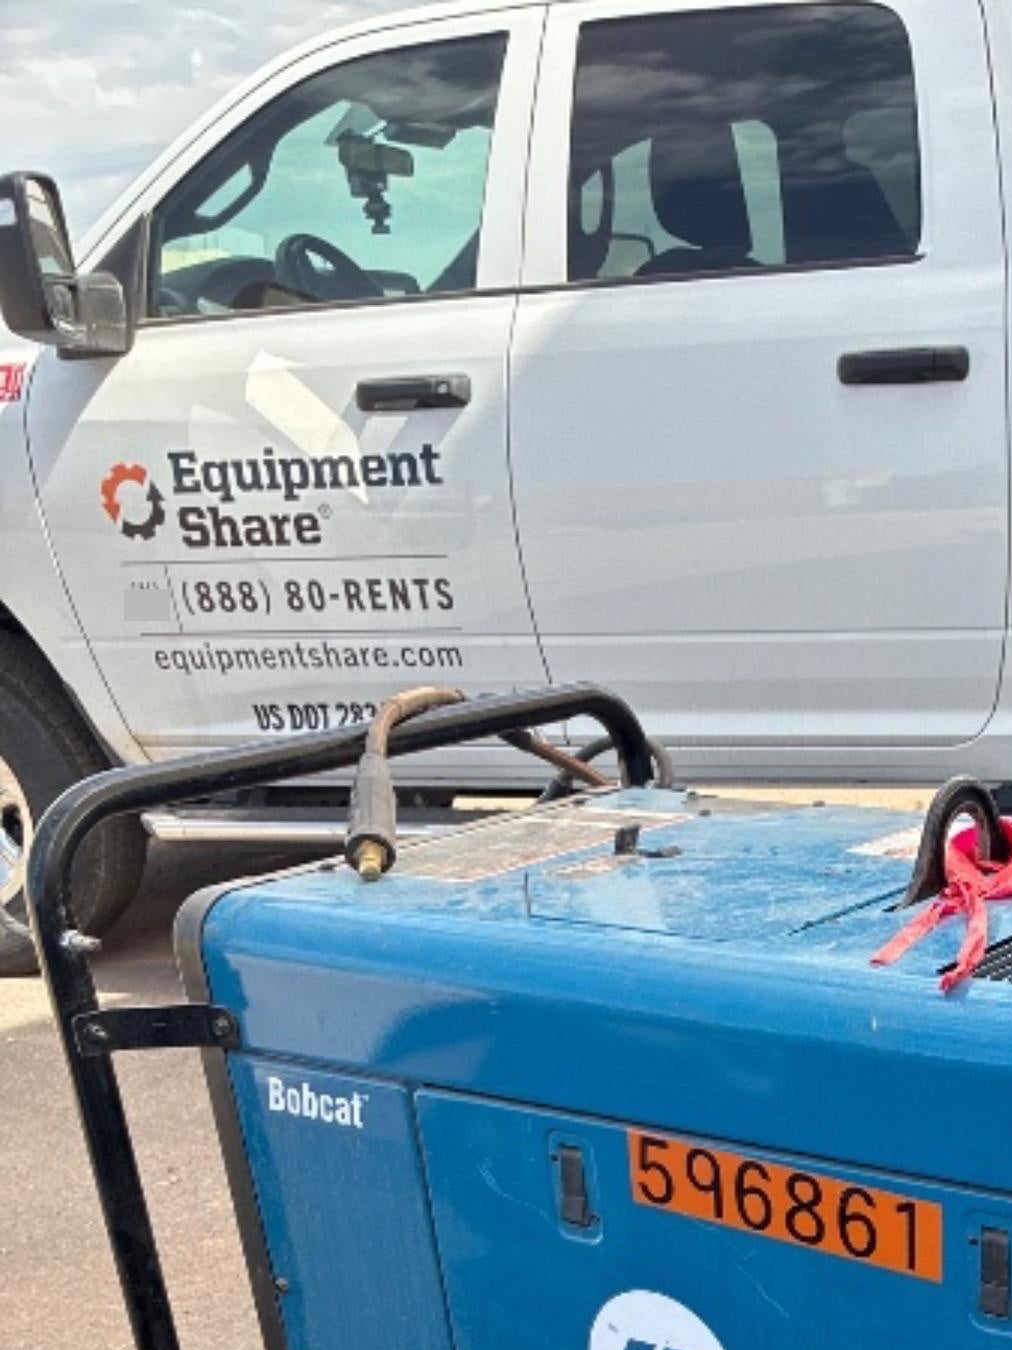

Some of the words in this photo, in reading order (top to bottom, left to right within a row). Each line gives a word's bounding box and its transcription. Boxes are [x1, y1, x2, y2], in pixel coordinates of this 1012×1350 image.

[167, 444, 444, 502] Equipment
[181, 580, 272, 616] (888)
[284, 578, 456, 613] 80-RENTS
[154, 643, 464, 676] equipmentshare.com
[252, 703, 285, 731] US
[286, 702, 329, 730] DOT
[638, 1136, 917, 1271] 596861
